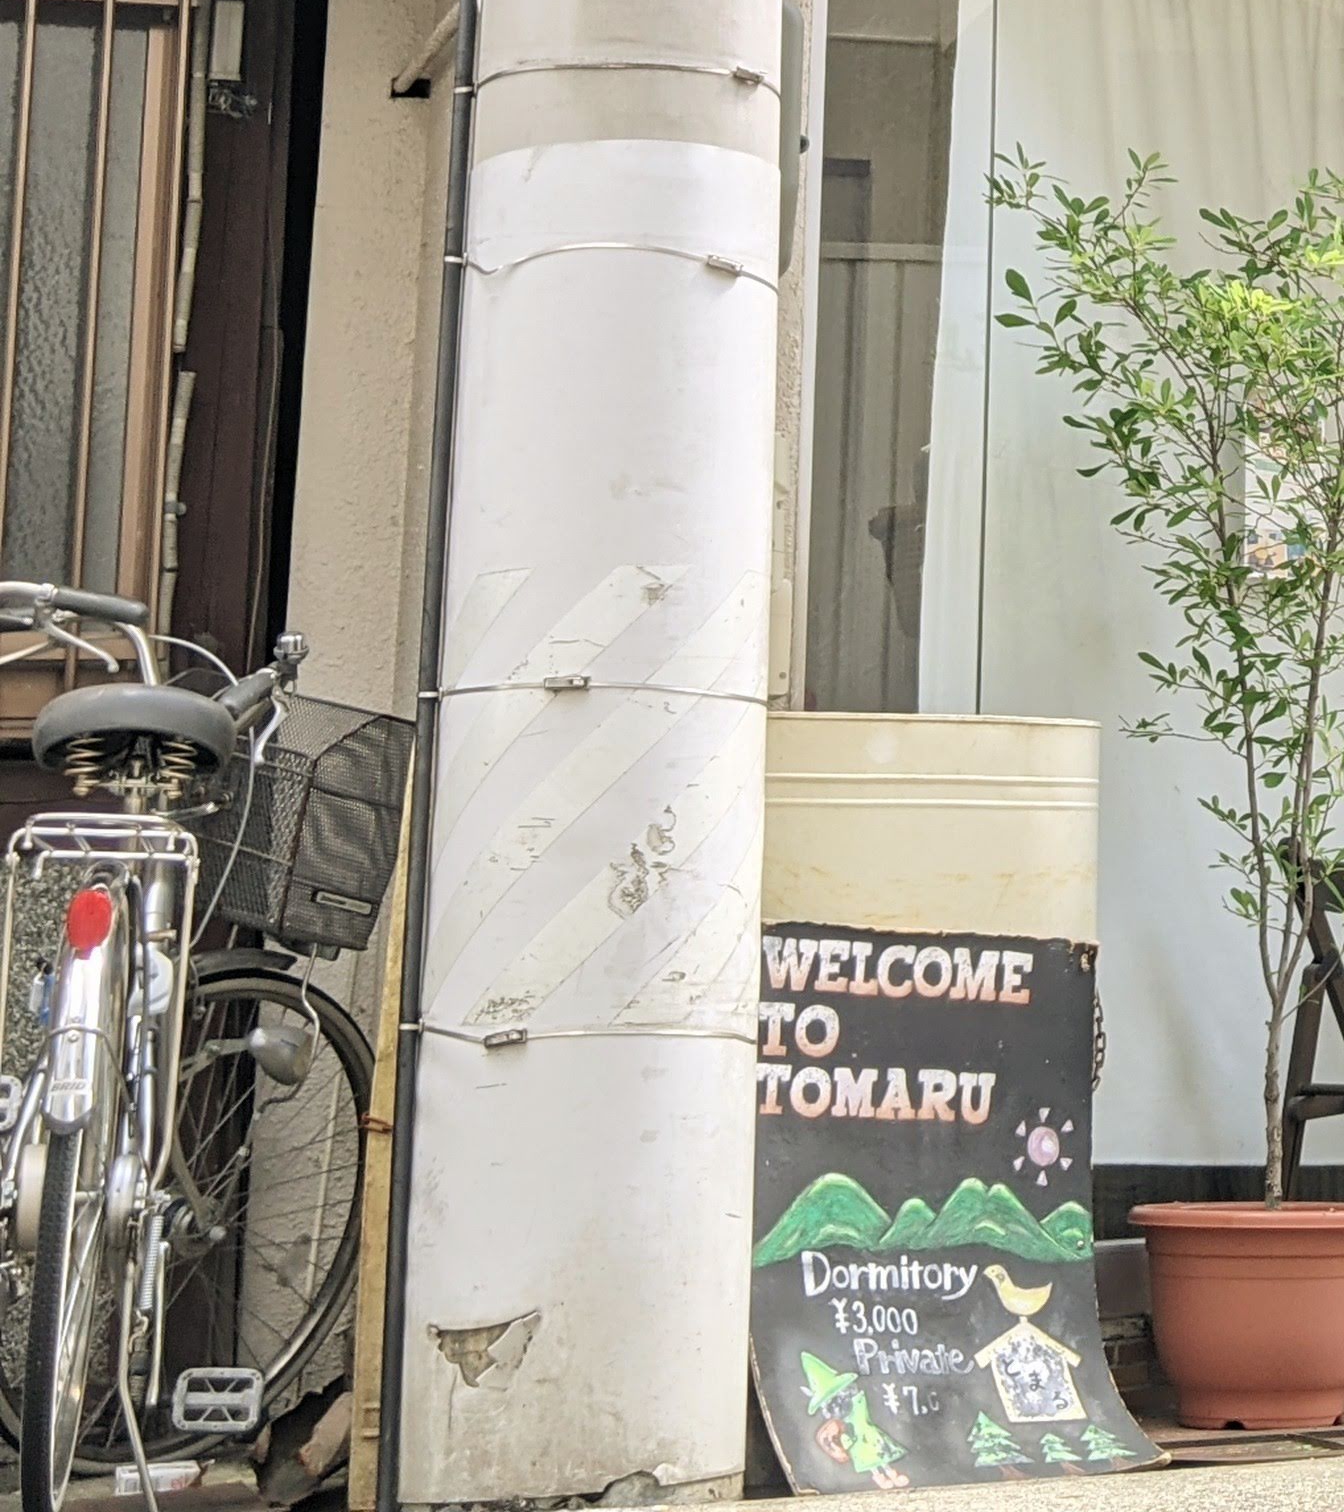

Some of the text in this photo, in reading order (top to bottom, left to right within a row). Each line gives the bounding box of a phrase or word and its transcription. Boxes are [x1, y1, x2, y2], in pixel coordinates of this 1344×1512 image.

[762, 935, 1034, 1005] WELCOME
[758, 1001, 840, 1058] TO
[755, 1062, 997, 1125] TOMARU
[801, 1250, 978, 1300] Dormitory
[853, 1338, 974, 1375] Private
